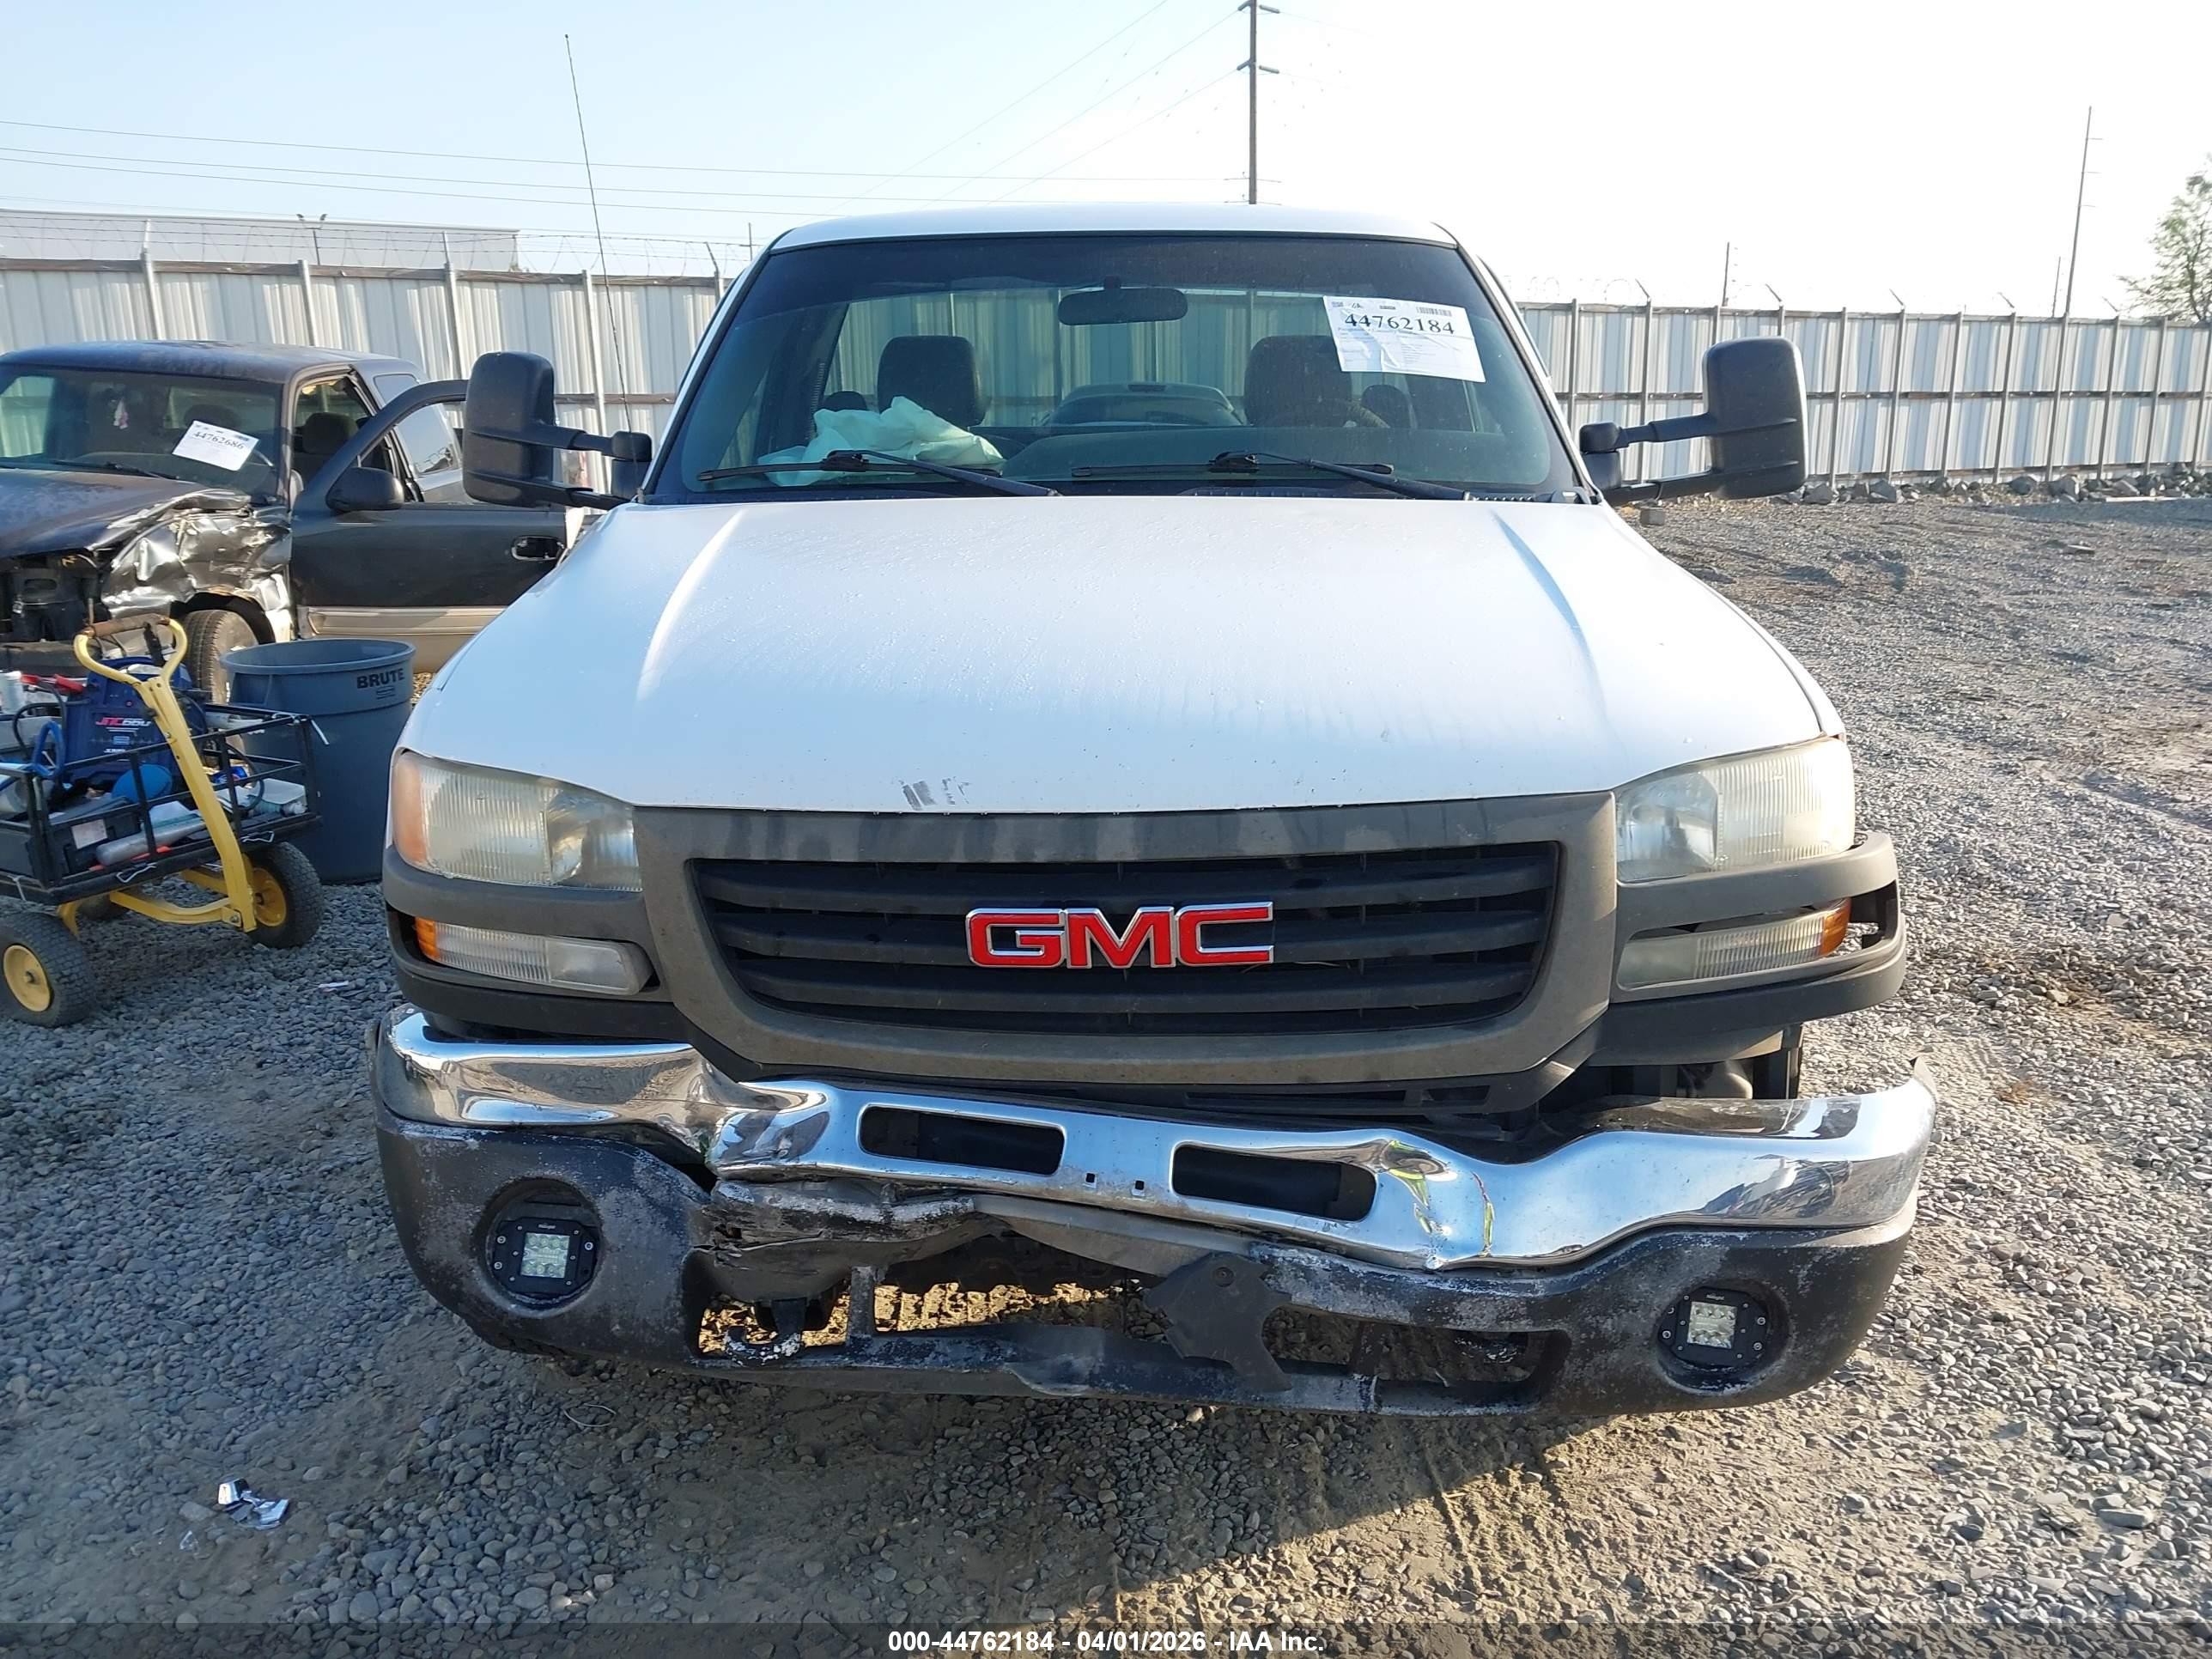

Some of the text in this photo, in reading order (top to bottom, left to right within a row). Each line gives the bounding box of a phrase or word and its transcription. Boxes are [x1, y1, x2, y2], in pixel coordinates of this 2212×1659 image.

[1345, 313, 1455, 335] 44762184
[193, 430, 245, 450] 44762686
[356, 668, 405, 689] BRUTE
[965, 901, 1274, 969] GMC
